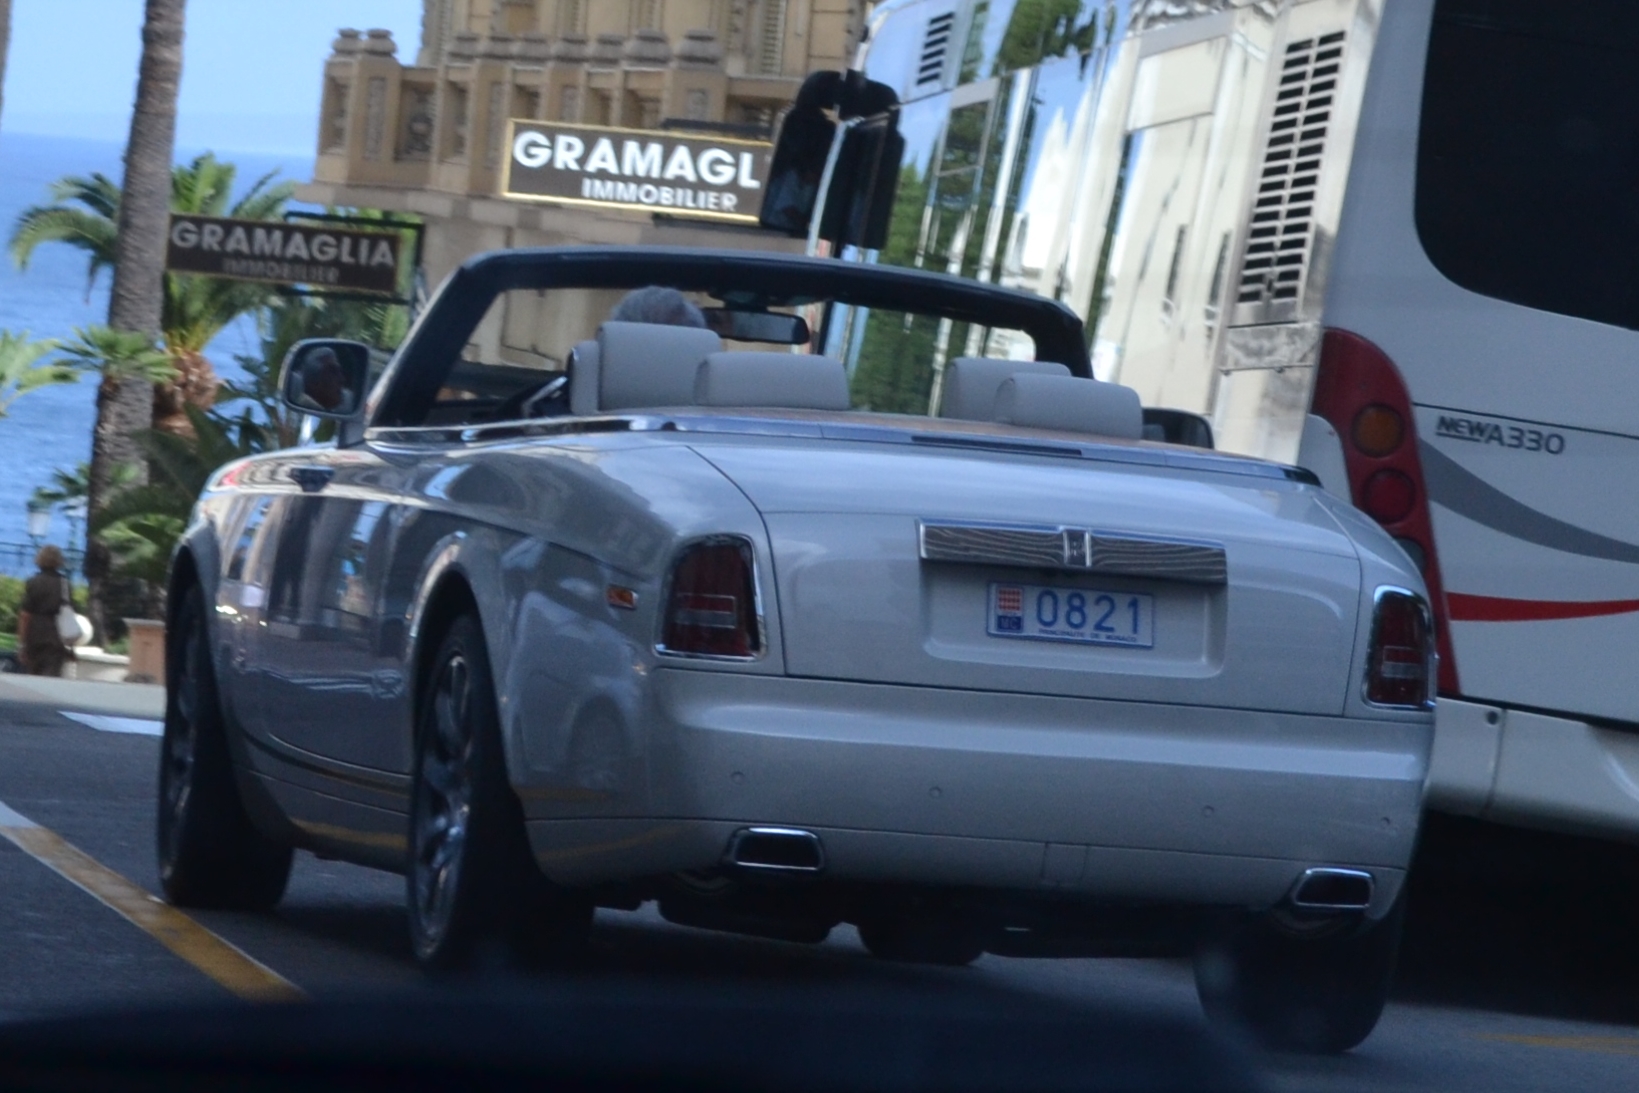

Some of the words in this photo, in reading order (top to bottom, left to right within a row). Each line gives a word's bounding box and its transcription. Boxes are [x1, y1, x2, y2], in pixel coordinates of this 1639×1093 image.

[513, 131, 769, 188] GRAMAGL
[581, 177, 738, 212] IMMOBILIER
[171, 220, 394, 268] GRAMAGLIA
[222, 257, 340, 284] IMMOBILIER
[1036, 589, 1139, 635] 0821
